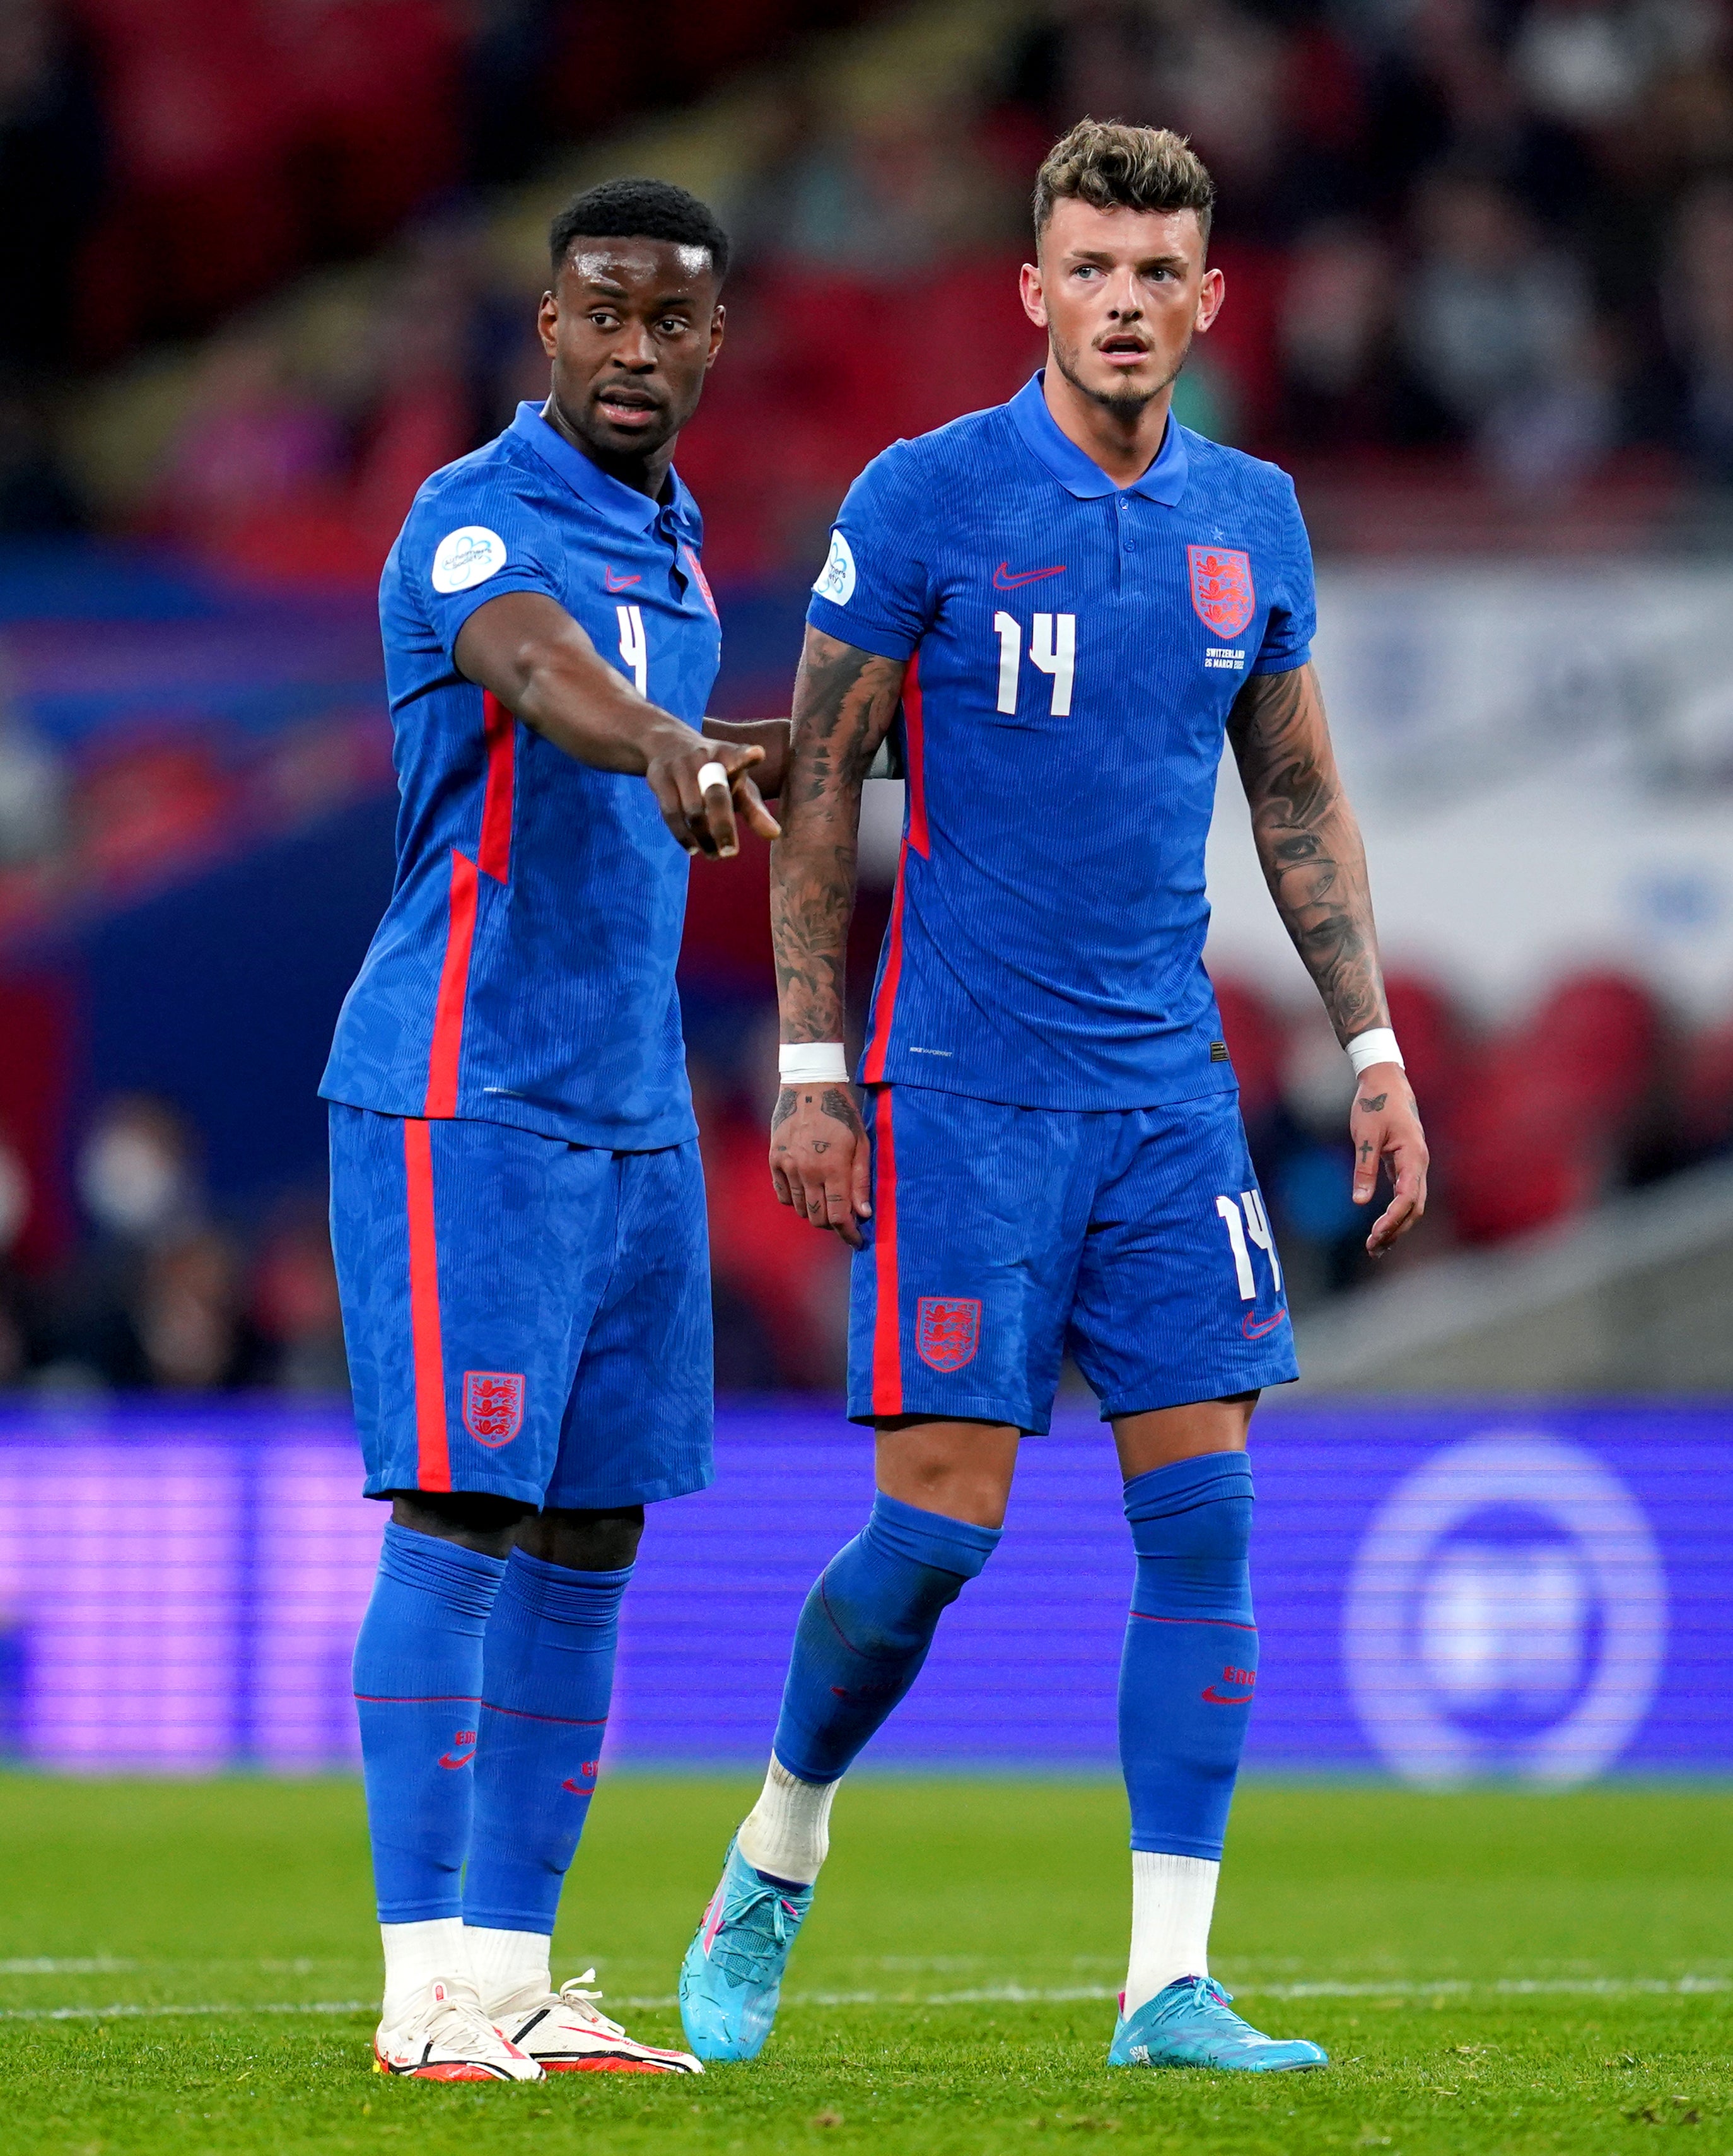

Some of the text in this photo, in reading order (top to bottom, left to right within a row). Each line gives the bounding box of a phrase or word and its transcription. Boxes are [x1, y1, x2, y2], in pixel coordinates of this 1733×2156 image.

[616, 606, 647, 700] 4
[994, 611, 1076, 716] 14
[1205, 658, 1213, 667] 26
[1213, 659, 1234, 669] MARCH
[1206, 648, 1246, 659] SWITZERLAND
[1215, 1189, 1281, 1301] 14
